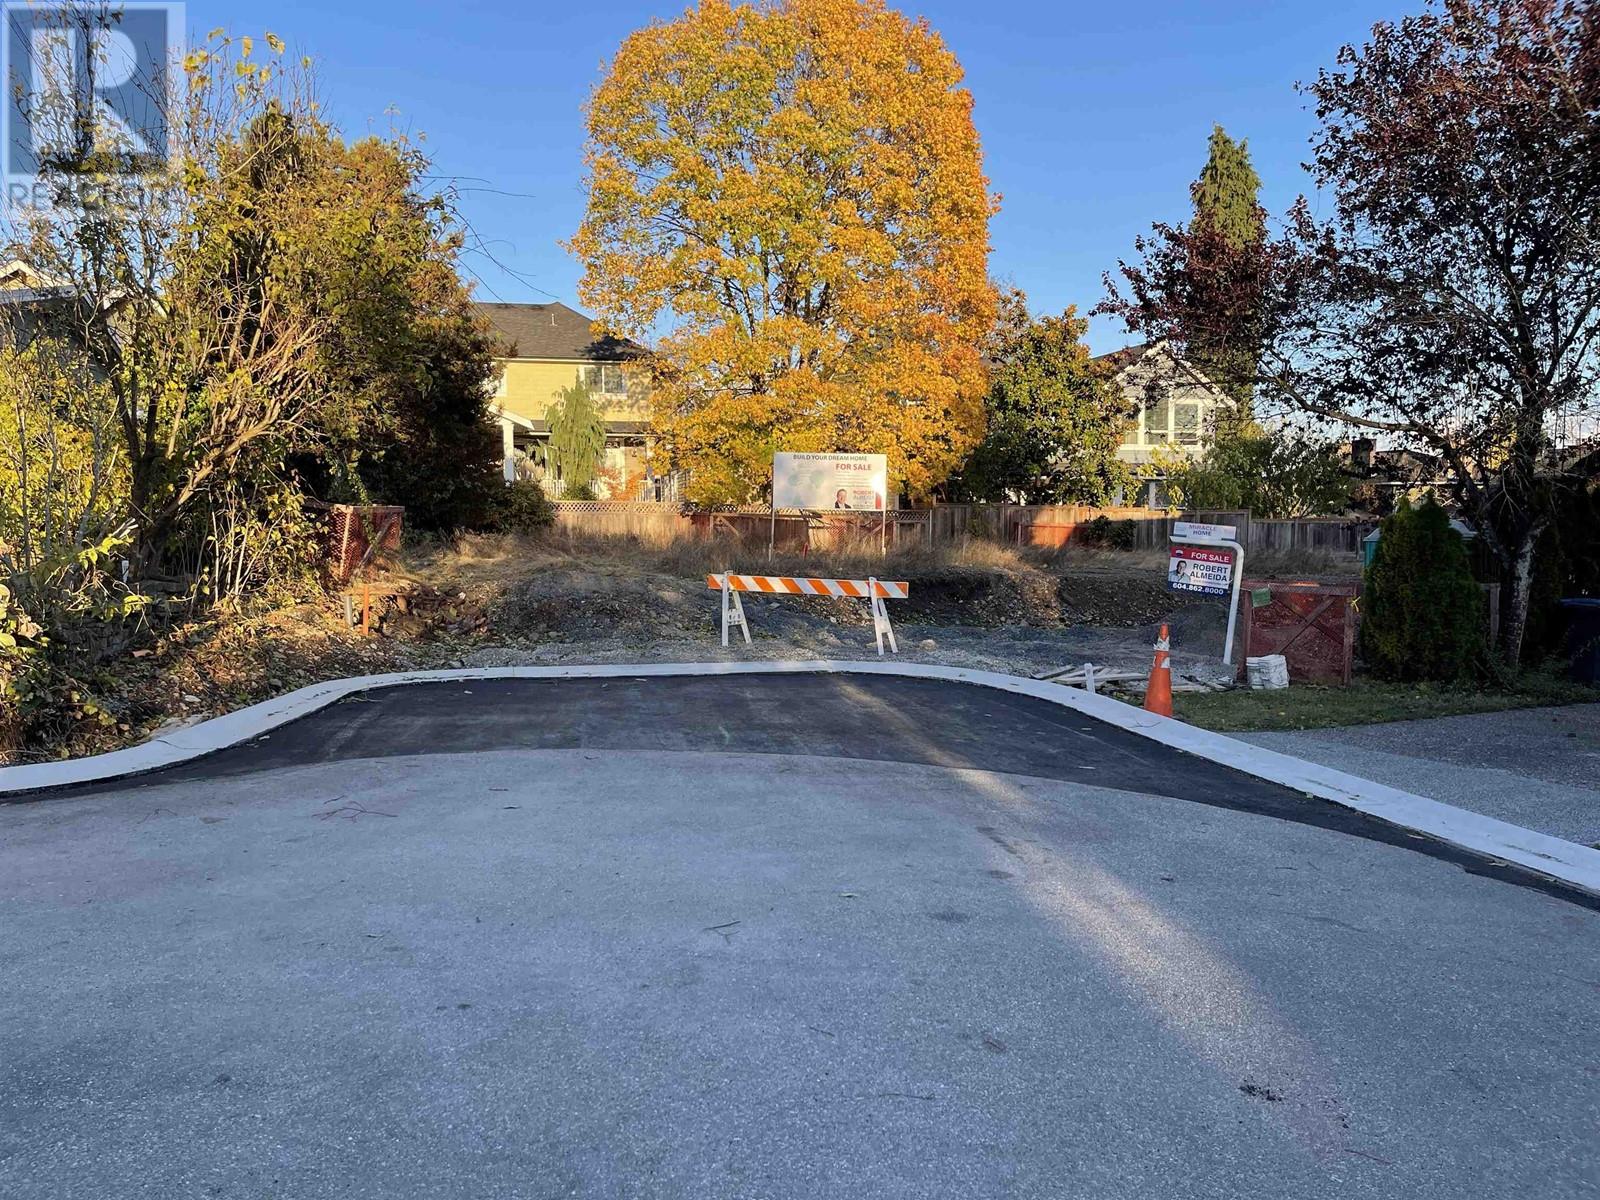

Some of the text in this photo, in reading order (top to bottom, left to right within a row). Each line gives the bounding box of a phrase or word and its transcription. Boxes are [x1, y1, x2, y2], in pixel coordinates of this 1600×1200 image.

[836, 463, 872, 471] FOR SALE
[1191, 551, 1230, 563] FOR SALE
[1193, 563, 1228, 574] ROBERT
[1189, 570, 1228, 582] ALMEIDA
[1172, 582, 1224, 595] 604.862.8000
